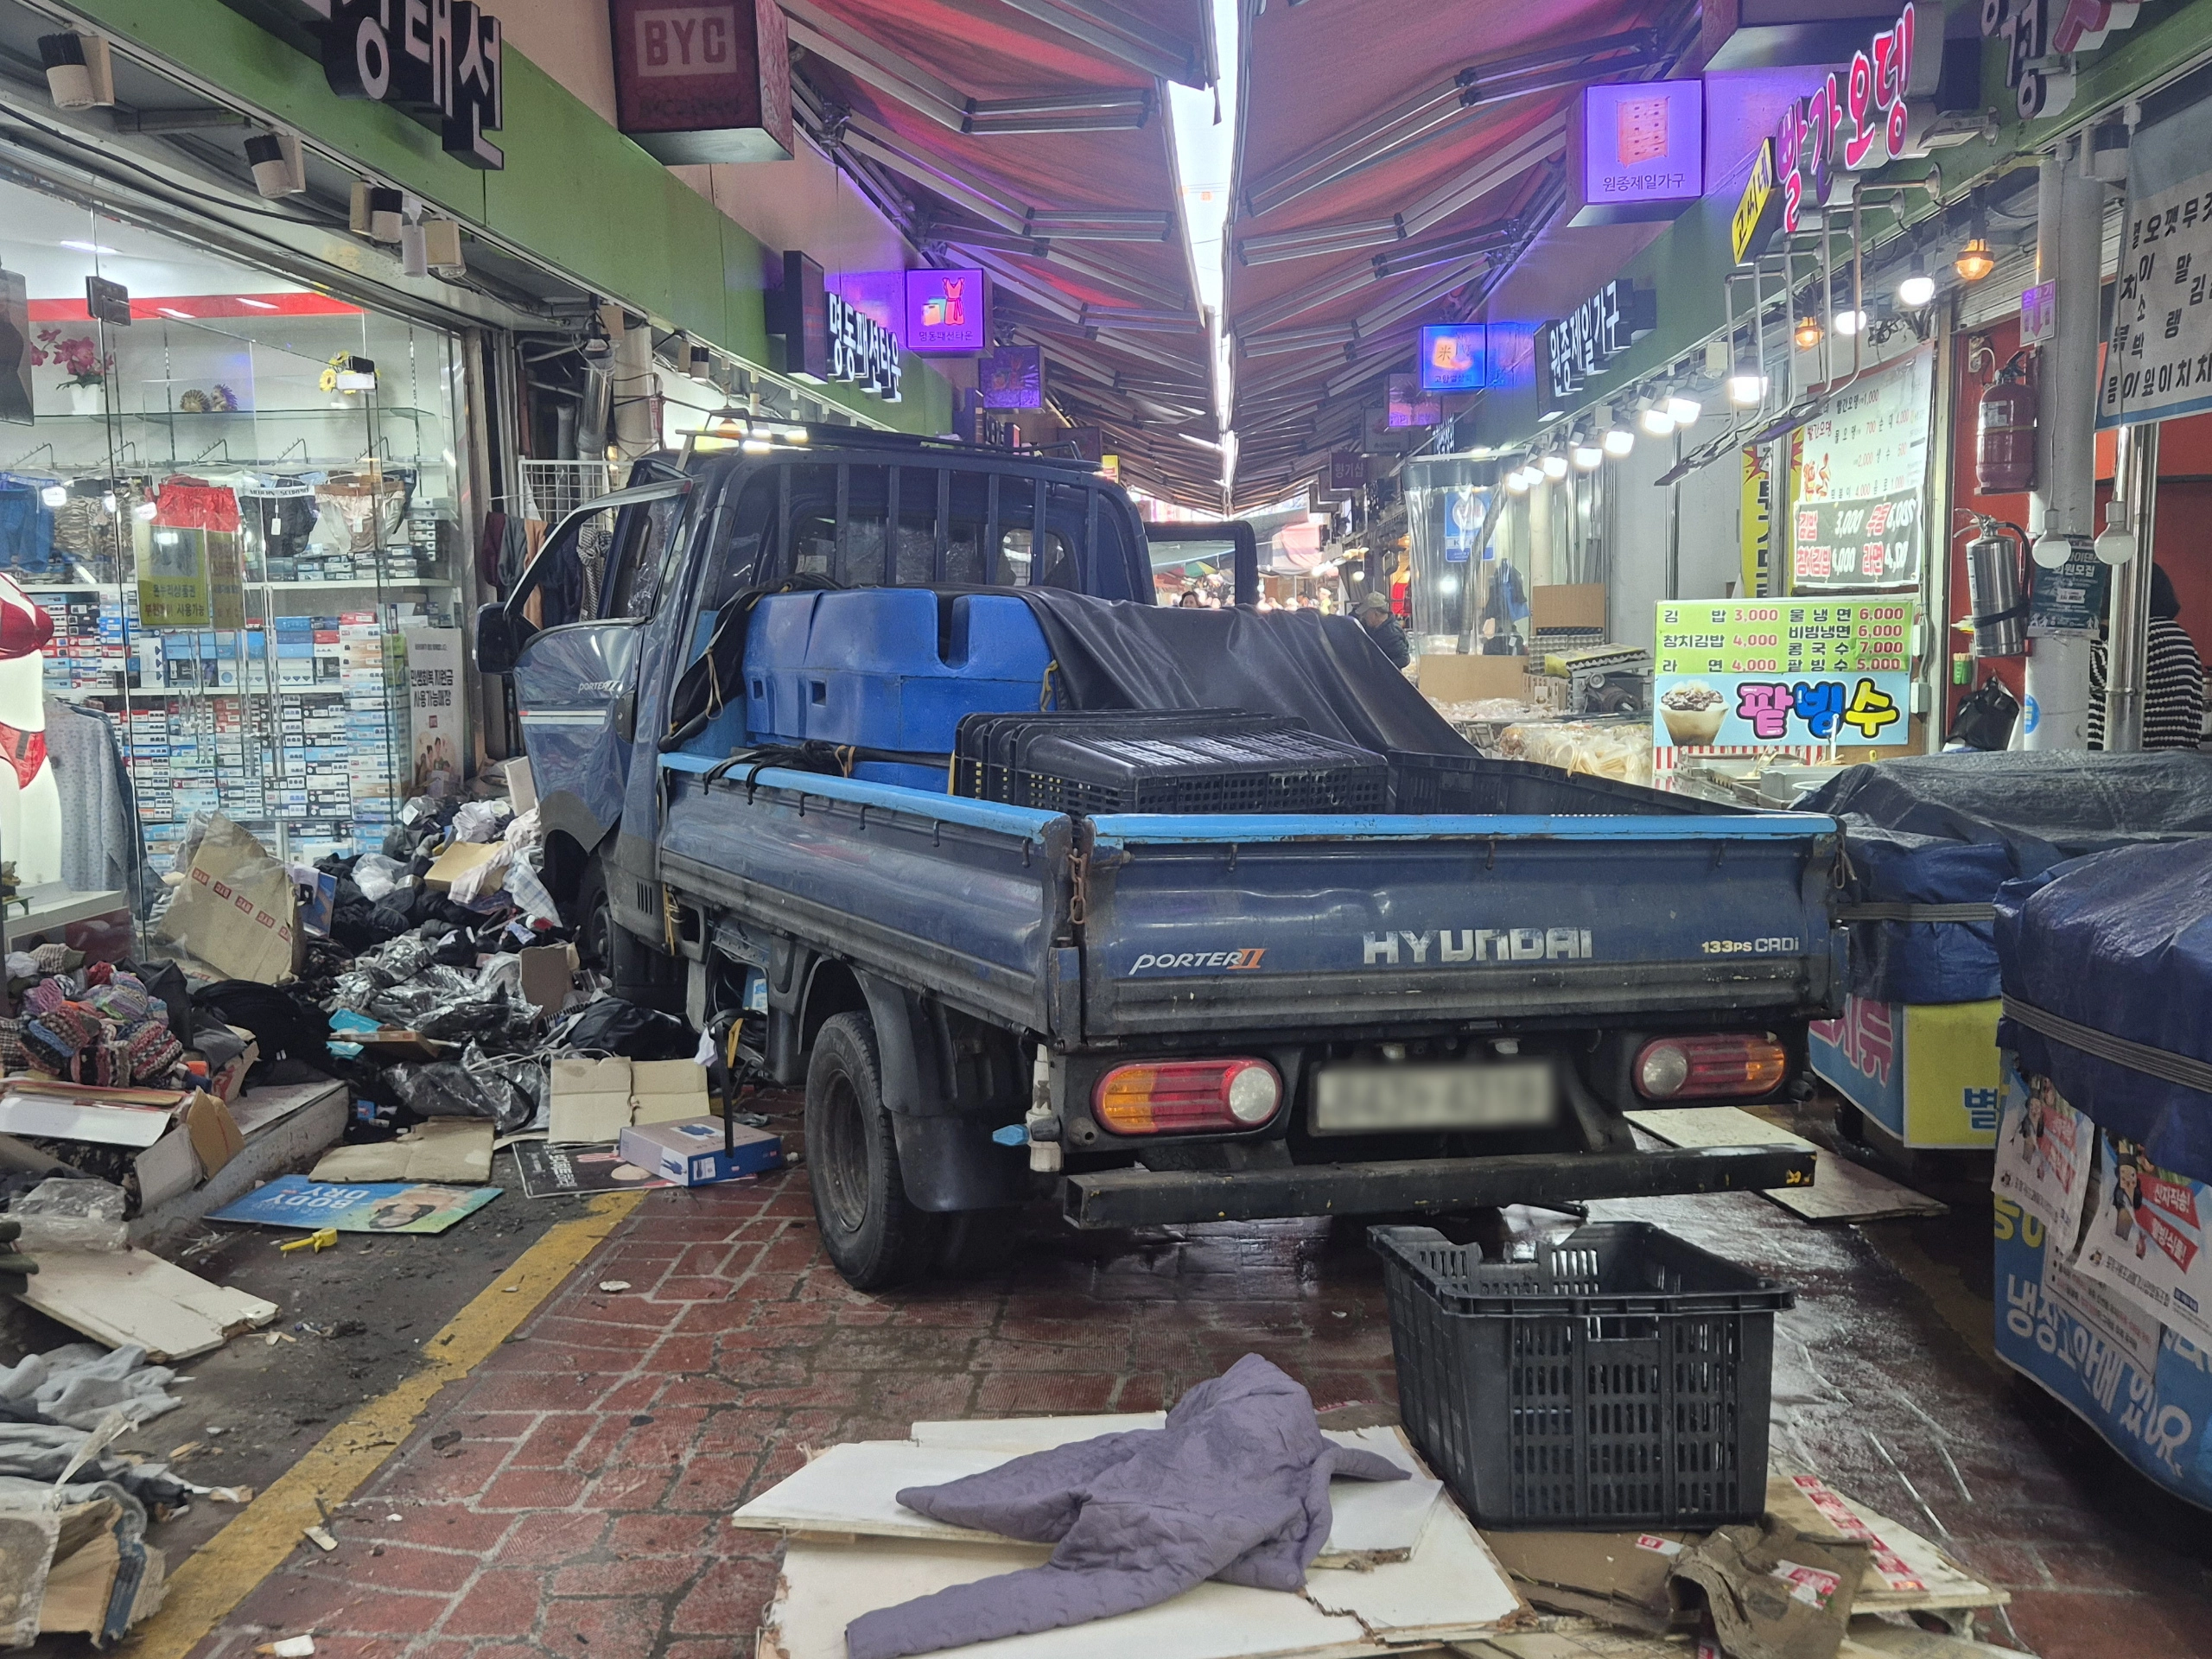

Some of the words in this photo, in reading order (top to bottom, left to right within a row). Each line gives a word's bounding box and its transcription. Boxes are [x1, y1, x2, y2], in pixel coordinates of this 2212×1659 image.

[645, 17, 726, 66] BYC
[1776, 2, 1915, 232] 빨간오뎅
[1603, 173, 1685, 192] 원종제일가구
[1736, 149, 1770, 256] 고씨네
[2023, 283, 2053, 307] 소화기
[918, 332, 973, 341] 명동패션타운
[1550, 280, 1619, 397] 원종제일가구
[830, 293, 901, 403] 명동패션타운
[1798, 511, 1818, 541] 김밥
[1835, 510, 1864, 537] 3,000
[1733, 609, 1778, 622] 3,000
[1859, 607, 1904, 620] 6,000
[1663, 634, 1726, 648] 참치김밥
[1732, 634, 1777, 647] 4,000
[1858, 625, 1903, 638] 6,000
[1859, 641, 1904, 655] 7,000
[1732, 659, 1777, 672] 4,000
[1857, 658, 1901, 671] 5,000
[1738, 679, 1898, 738] 팥빙수
[1363, 927, 1592, 964] HYUNDAI
